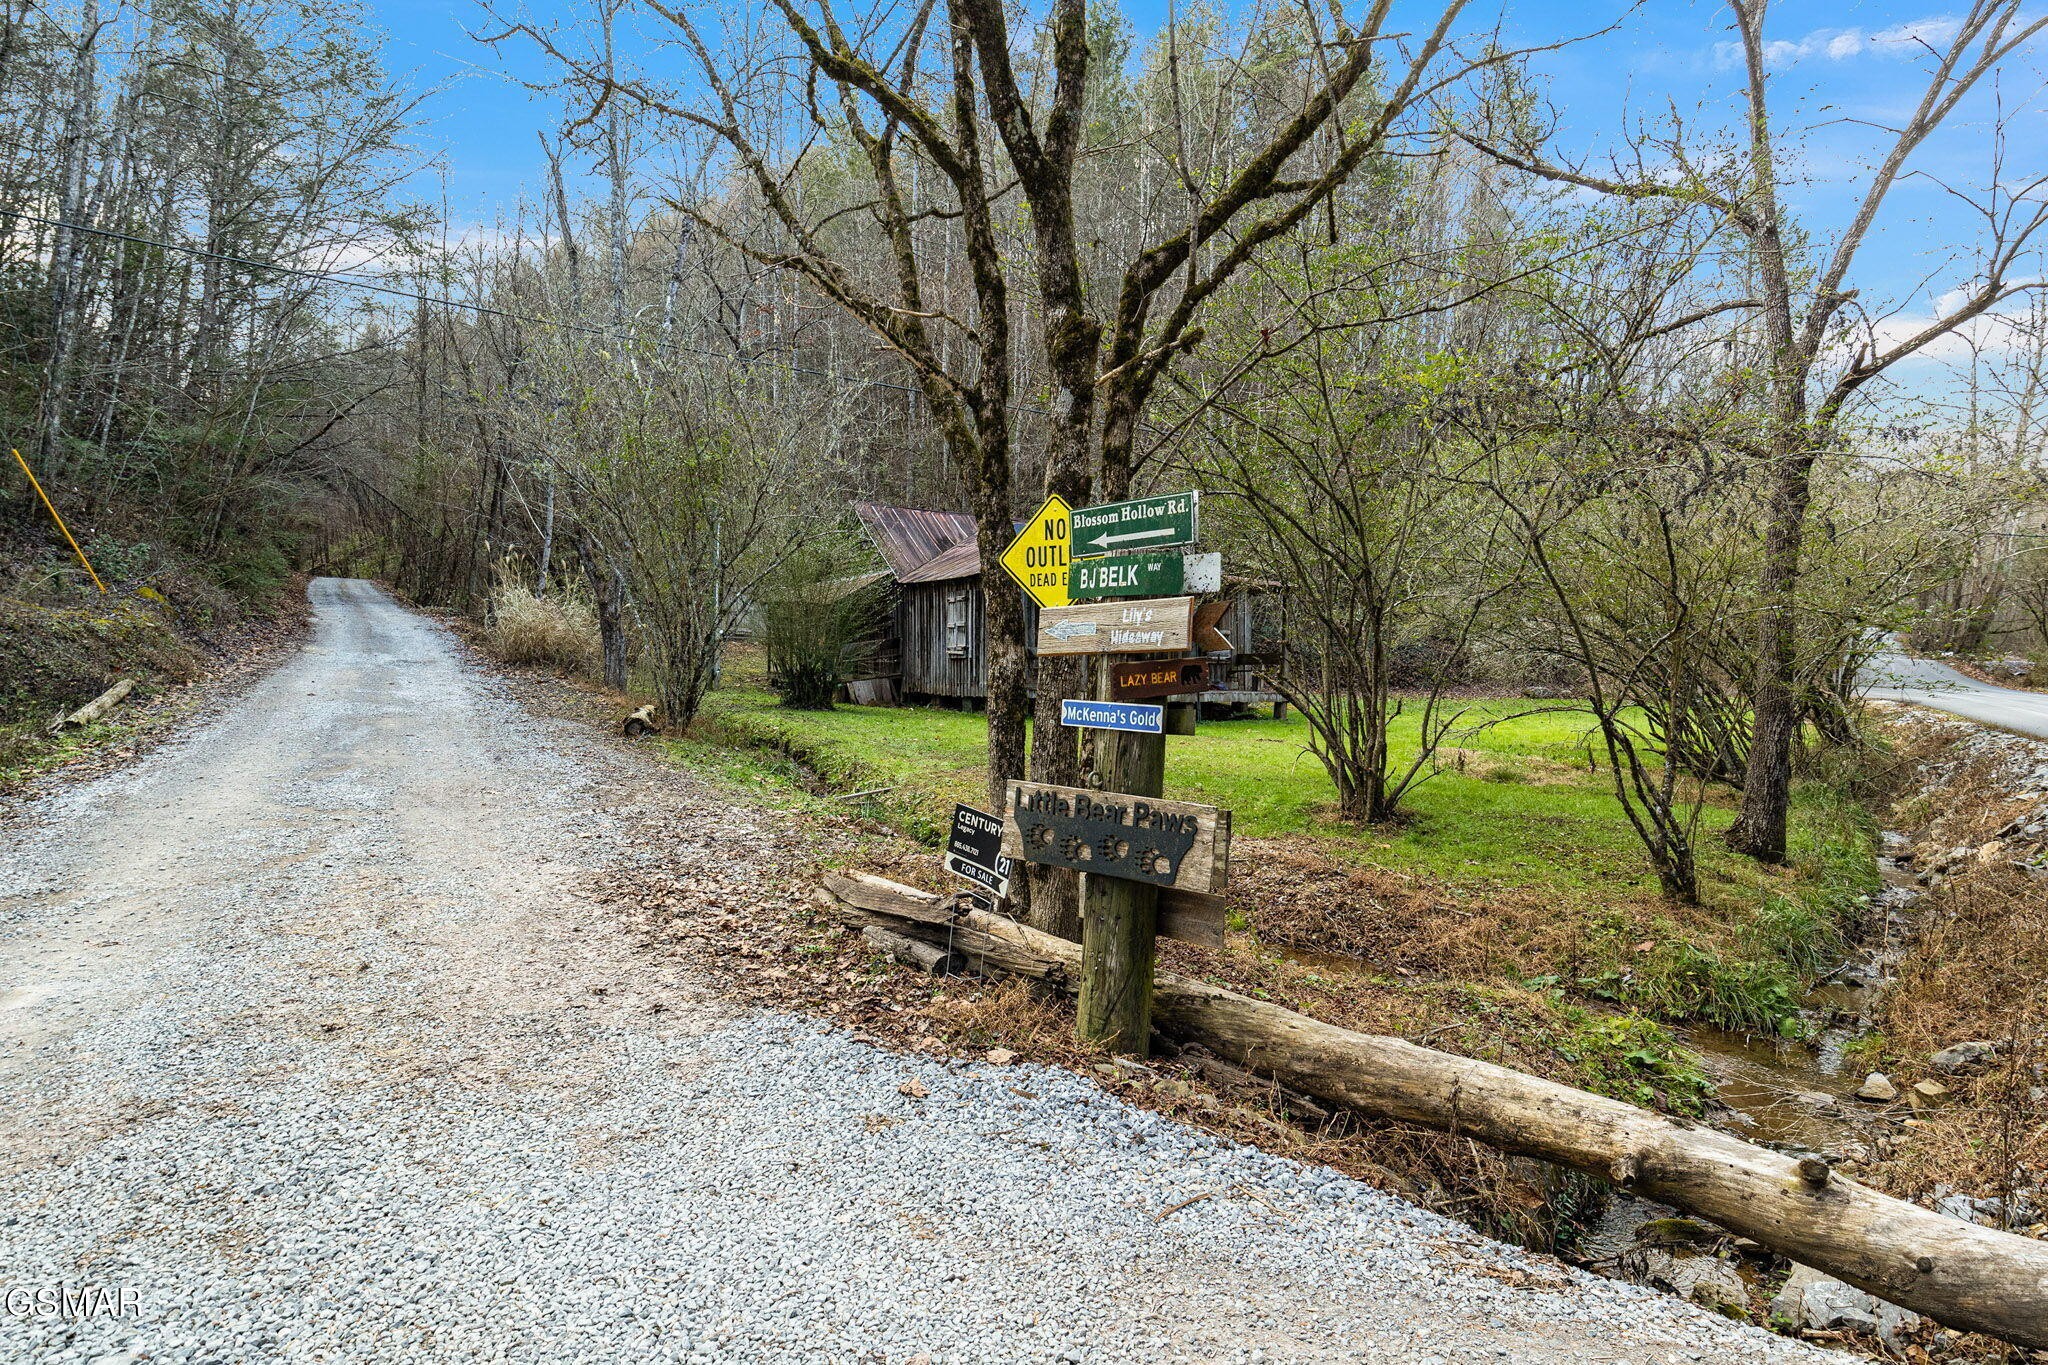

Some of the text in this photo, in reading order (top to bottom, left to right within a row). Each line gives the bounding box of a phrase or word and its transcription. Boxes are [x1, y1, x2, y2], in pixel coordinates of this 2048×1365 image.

[1073, 499, 1189, 529] Blossom Hollow Rd.
[1044, 519, 1066, 540] NO
[1026, 545, 1072, 568] OUTL
[1030, 573, 1057, 587] DEAD
[1080, 567, 1096, 589] BJ
[1099, 564, 1139, 587] BELK
[1147, 562, 1162, 572] WAY
[1122, 607, 1153, 627] Lily's
[1120, 670, 1177, 688] LAZY BEAR
[1067, 705, 1156, 727] McKenna's Gold
[1015, 786, 1198, 836] Little Bear Paws
[957, 822, 976, 836] Legacy
[958, 810, 1003, 838] CENTURY
[961, 863, 993, 885] FOR SALE
[999, 857, 1010, 875] 21
